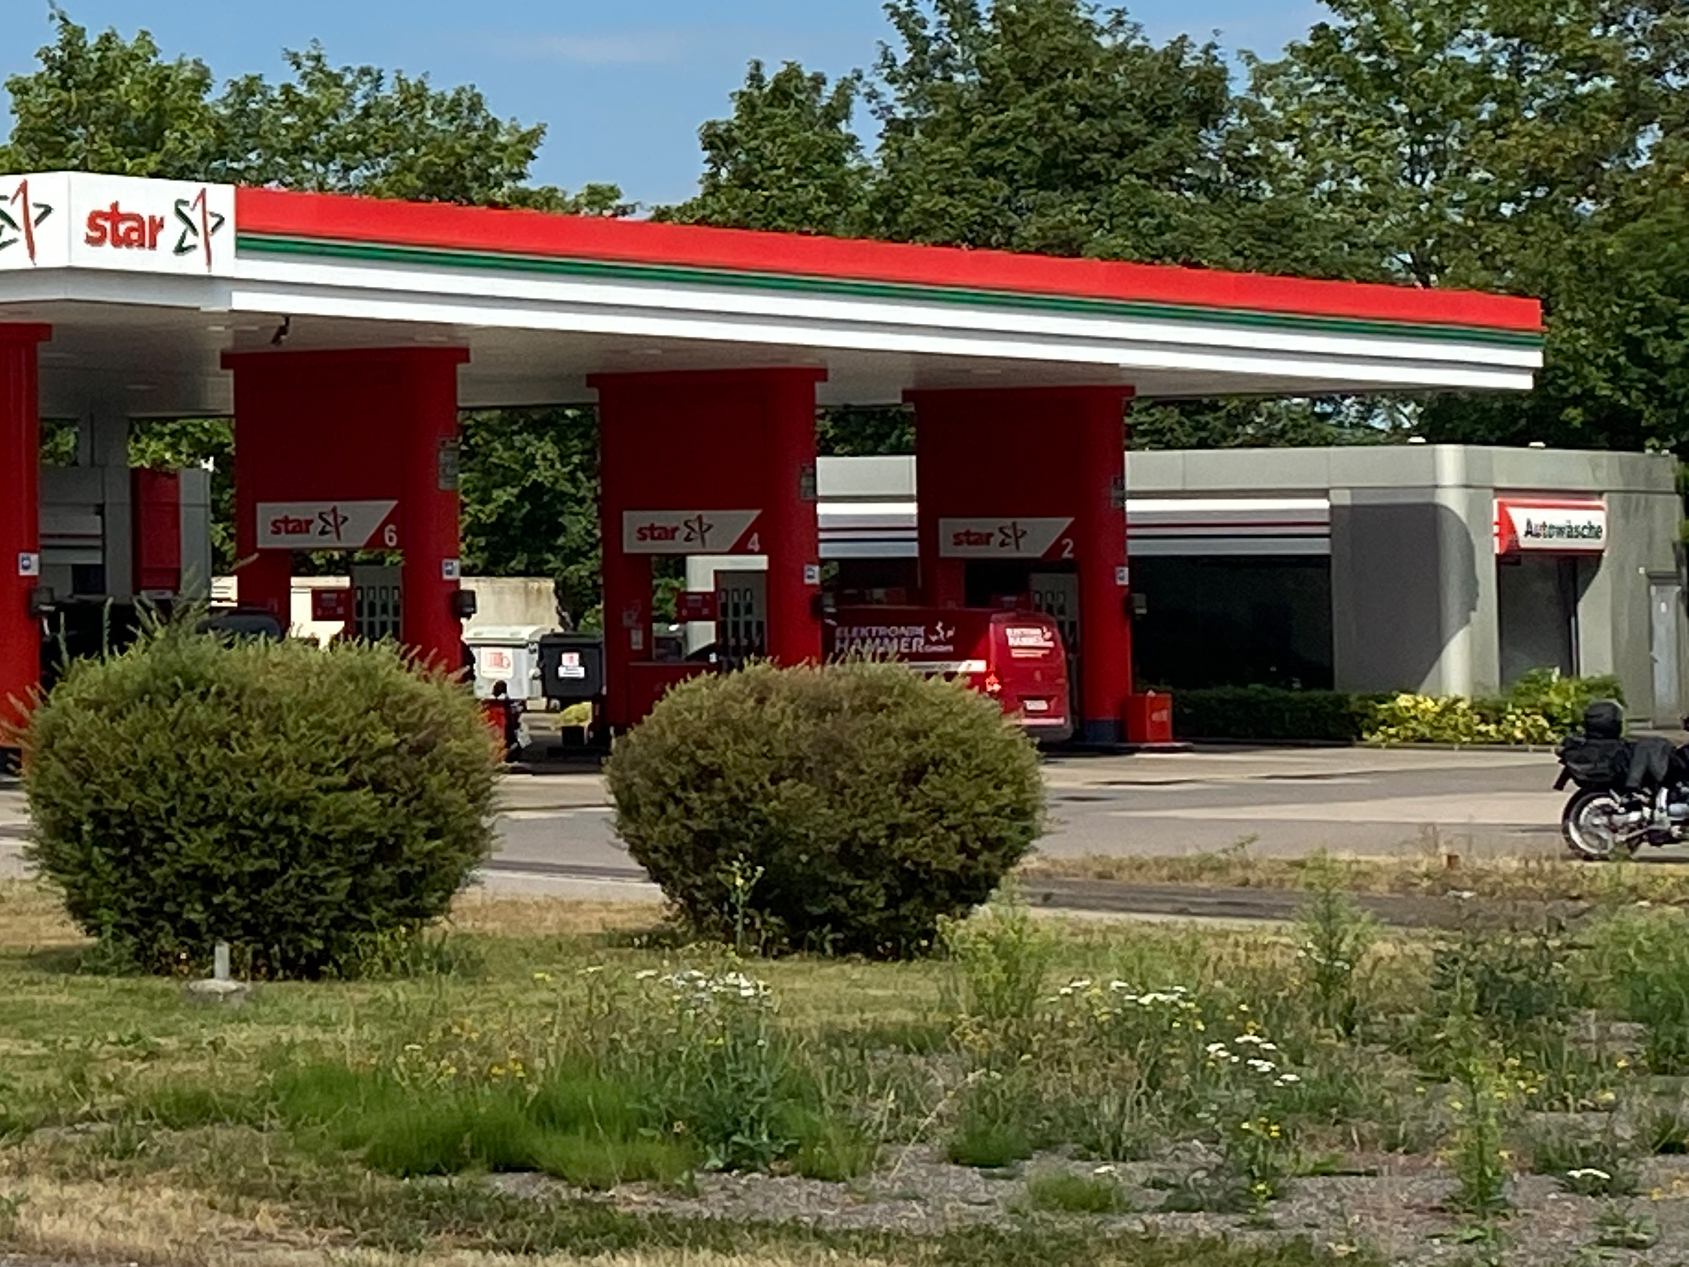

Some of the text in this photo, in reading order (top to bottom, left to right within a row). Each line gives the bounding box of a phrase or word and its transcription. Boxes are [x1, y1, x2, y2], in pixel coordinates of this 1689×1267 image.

[84, 201, 164, 251] star
[270, 514, 314, 536] star
[636, 522, 680, 542] star
[1524, 518, 1603, 540] Autowäsche
[383, 525, 398, 547] 6
[747, 533, 760, 553] 4
[952, 528, 994, 547] star
[1061, 539, 1074, 558] 2
